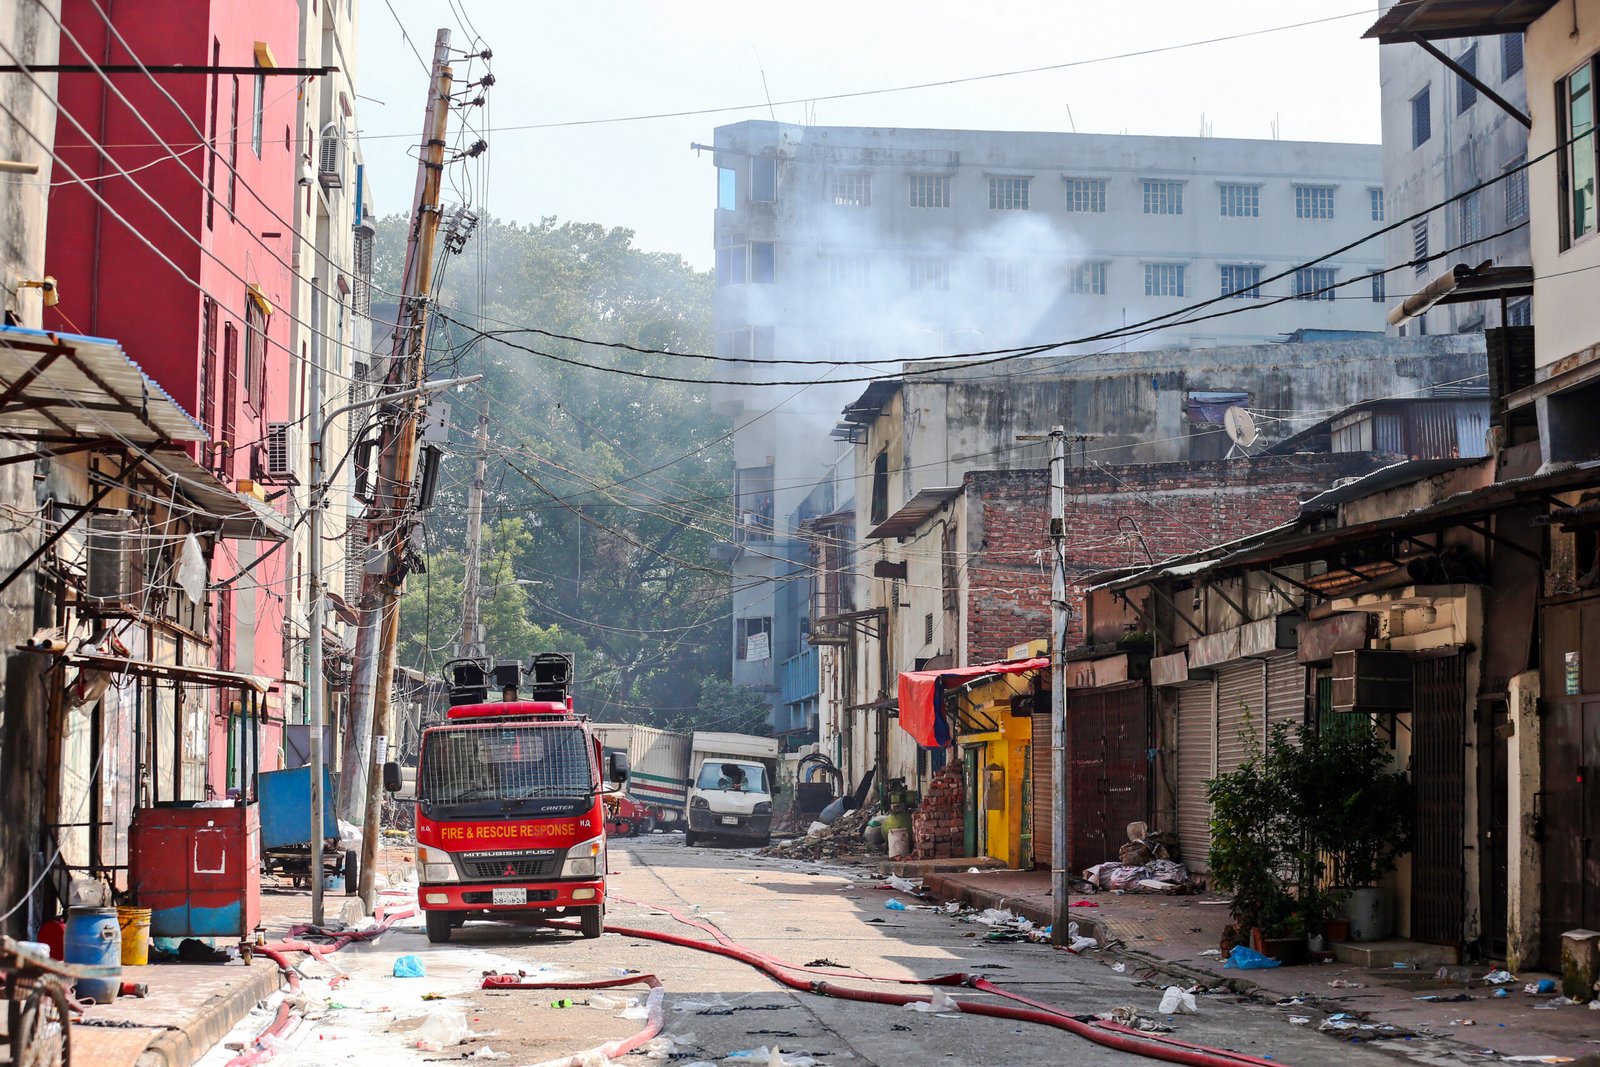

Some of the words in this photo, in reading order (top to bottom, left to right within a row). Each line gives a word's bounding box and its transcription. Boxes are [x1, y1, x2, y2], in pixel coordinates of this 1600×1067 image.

[441, 826, 464, 840] FIRE
[466, 826, 474, 839] &
[476, 825, 518, 839] RESCUE
[520, 823, 575, 837] RESPONSE
